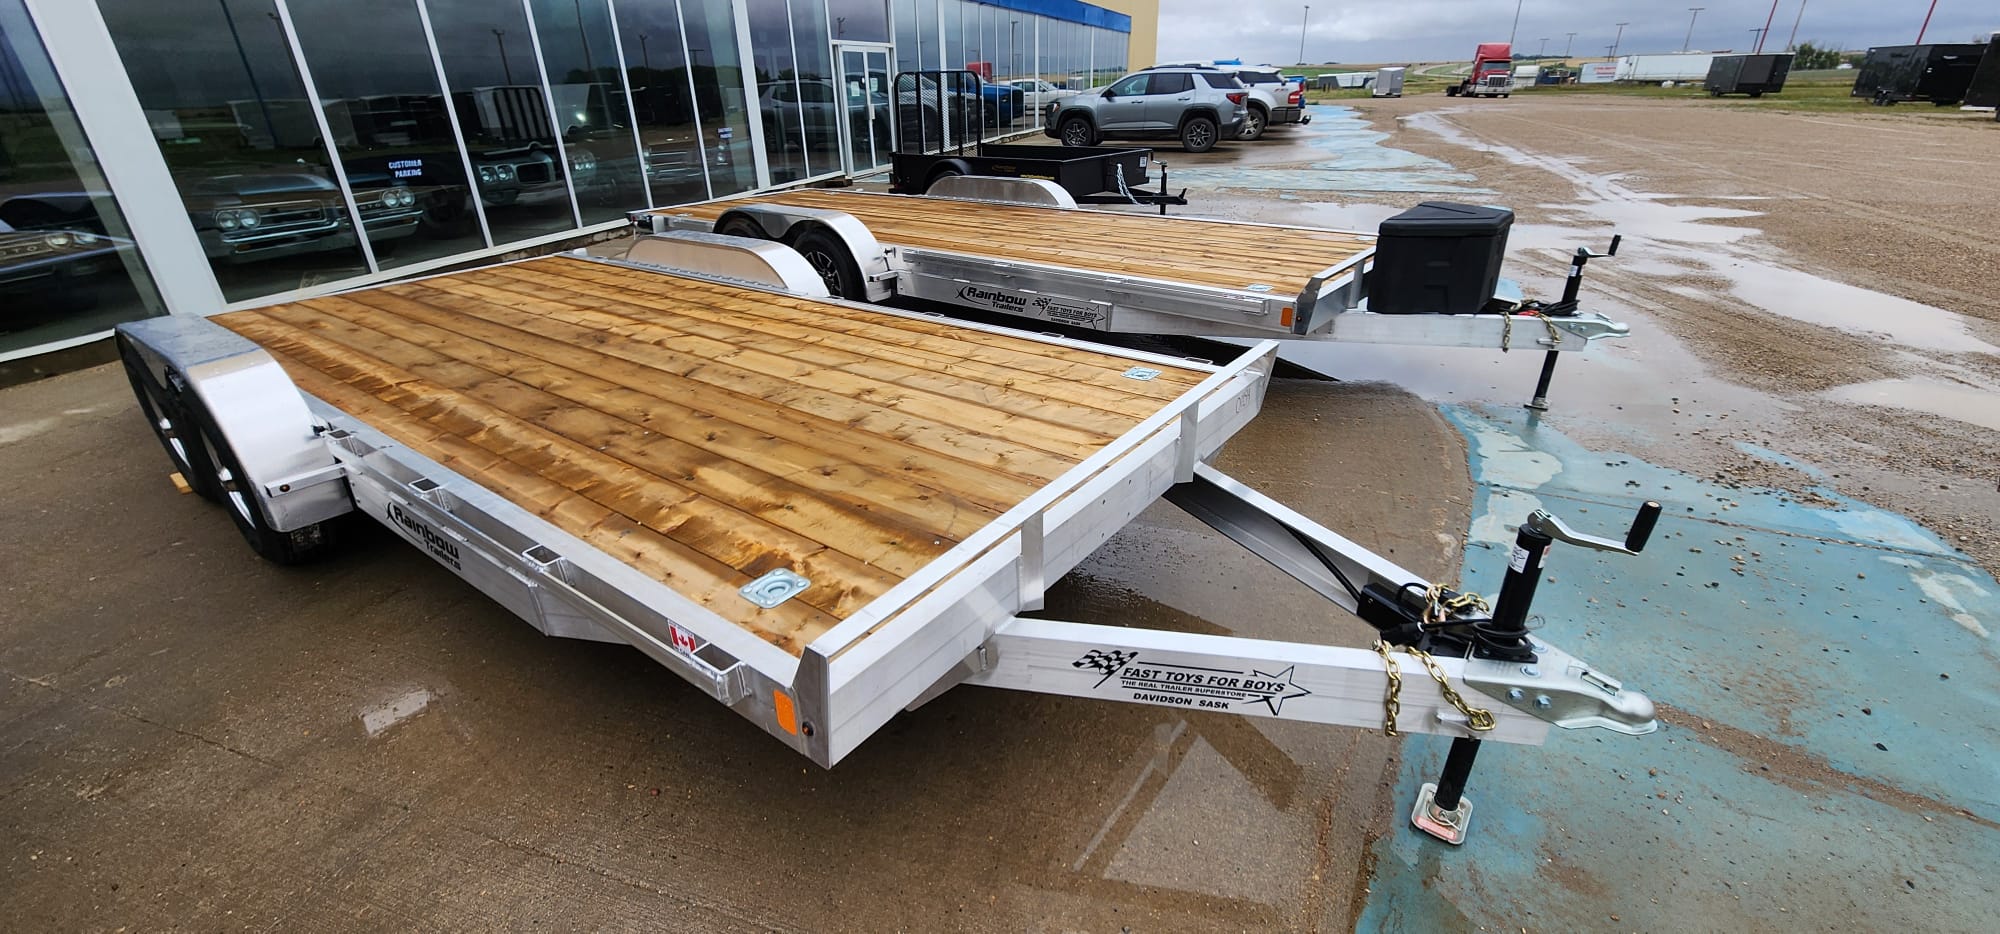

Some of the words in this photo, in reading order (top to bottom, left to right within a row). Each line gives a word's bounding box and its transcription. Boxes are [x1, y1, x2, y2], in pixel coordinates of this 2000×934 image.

[394, 169, 422, 178] PARKING
[967, 286, 1027, 306] Rainbow
[992, 301, 1024, 313] Trailers
[393, 505, 460, 560] Rainbow
[424, 539, 461, 571] Trailers
[1122, 667, 1162, 679] FAST
[1165, 671, 1205, 684] TOYS
[1206, 676, 1240, 688] FOR
[1242, 679, 1286, 692] BOYS
[1138, 681, 1158, 689] REAL
[1160, 684, 1193, 692] TRAILER
[1194, 687, 1247, 697] SUPERSTORE
[1133, 692, 1193, 706] DAVIDSON
[1198, 699, 1230, 709] SASK
